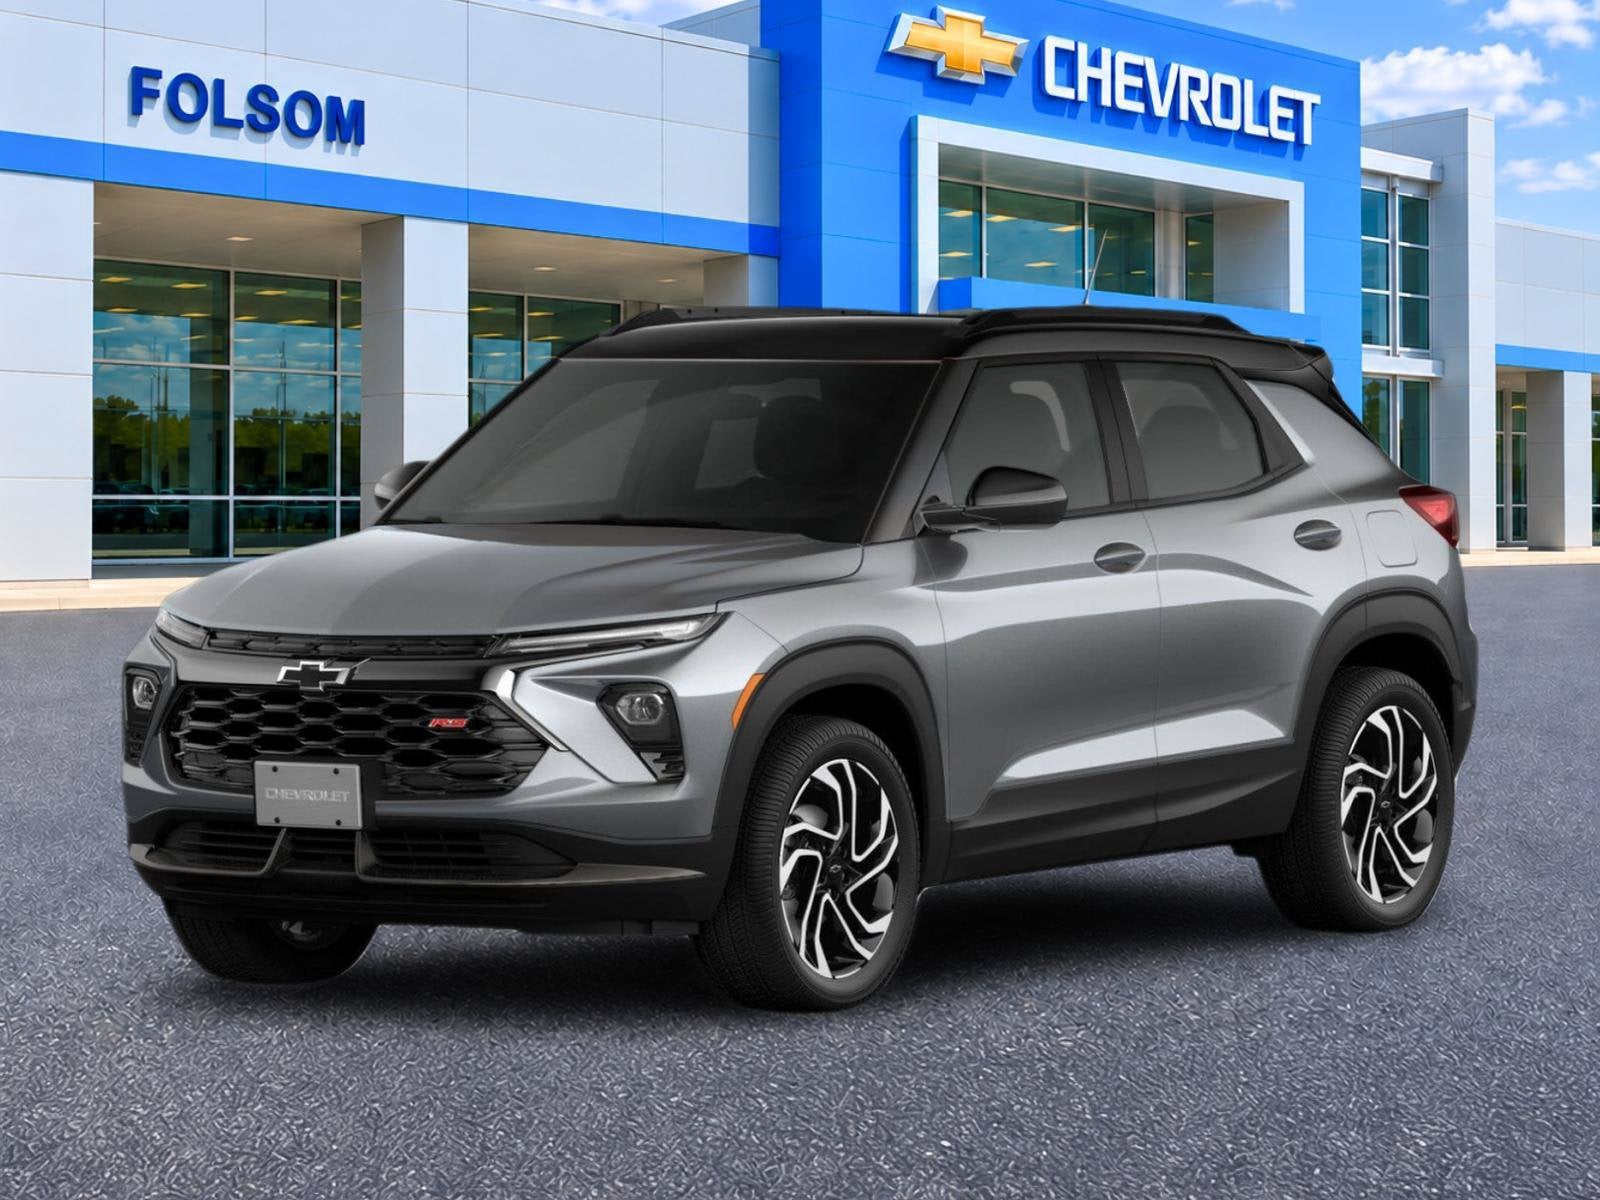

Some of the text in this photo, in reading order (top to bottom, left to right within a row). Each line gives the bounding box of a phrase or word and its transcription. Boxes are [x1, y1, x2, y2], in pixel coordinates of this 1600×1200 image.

[130, 65, 366, 146] FOLSOM
[1043, 35, 1321, 145] CHEVROLET
[429, 718, 467, 728] RS
[265, 788, 350, 802] CHEVROLET
